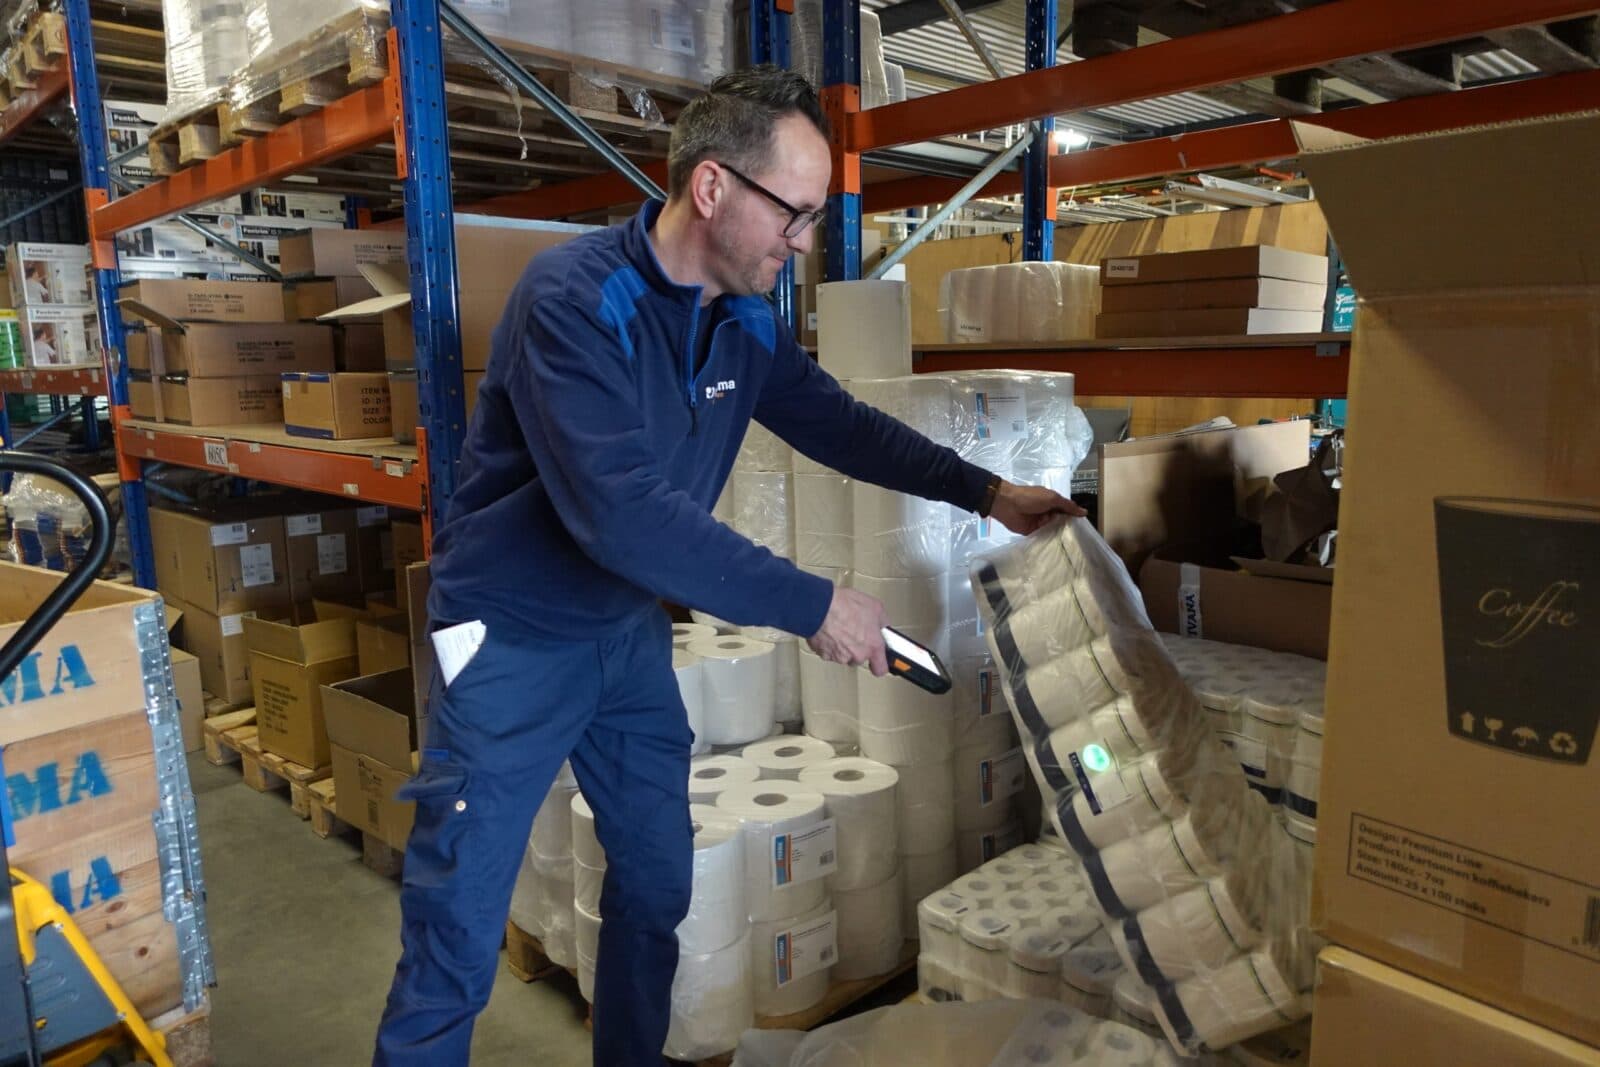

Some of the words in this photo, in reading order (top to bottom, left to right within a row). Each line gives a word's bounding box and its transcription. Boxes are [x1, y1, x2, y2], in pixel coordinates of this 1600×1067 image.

[1473, 580, 1580, 648] Coffee
[1359, 823, 1400, 844] Design:
[1402, 836, 1454, 861] Premium
[1456, 853, 1483, 870] Line
[1408, 851, 1470, 879] kartonnen
[1356, 861, 1402, 885] Amount:
[1454, 896, 1487, 915] stuks
